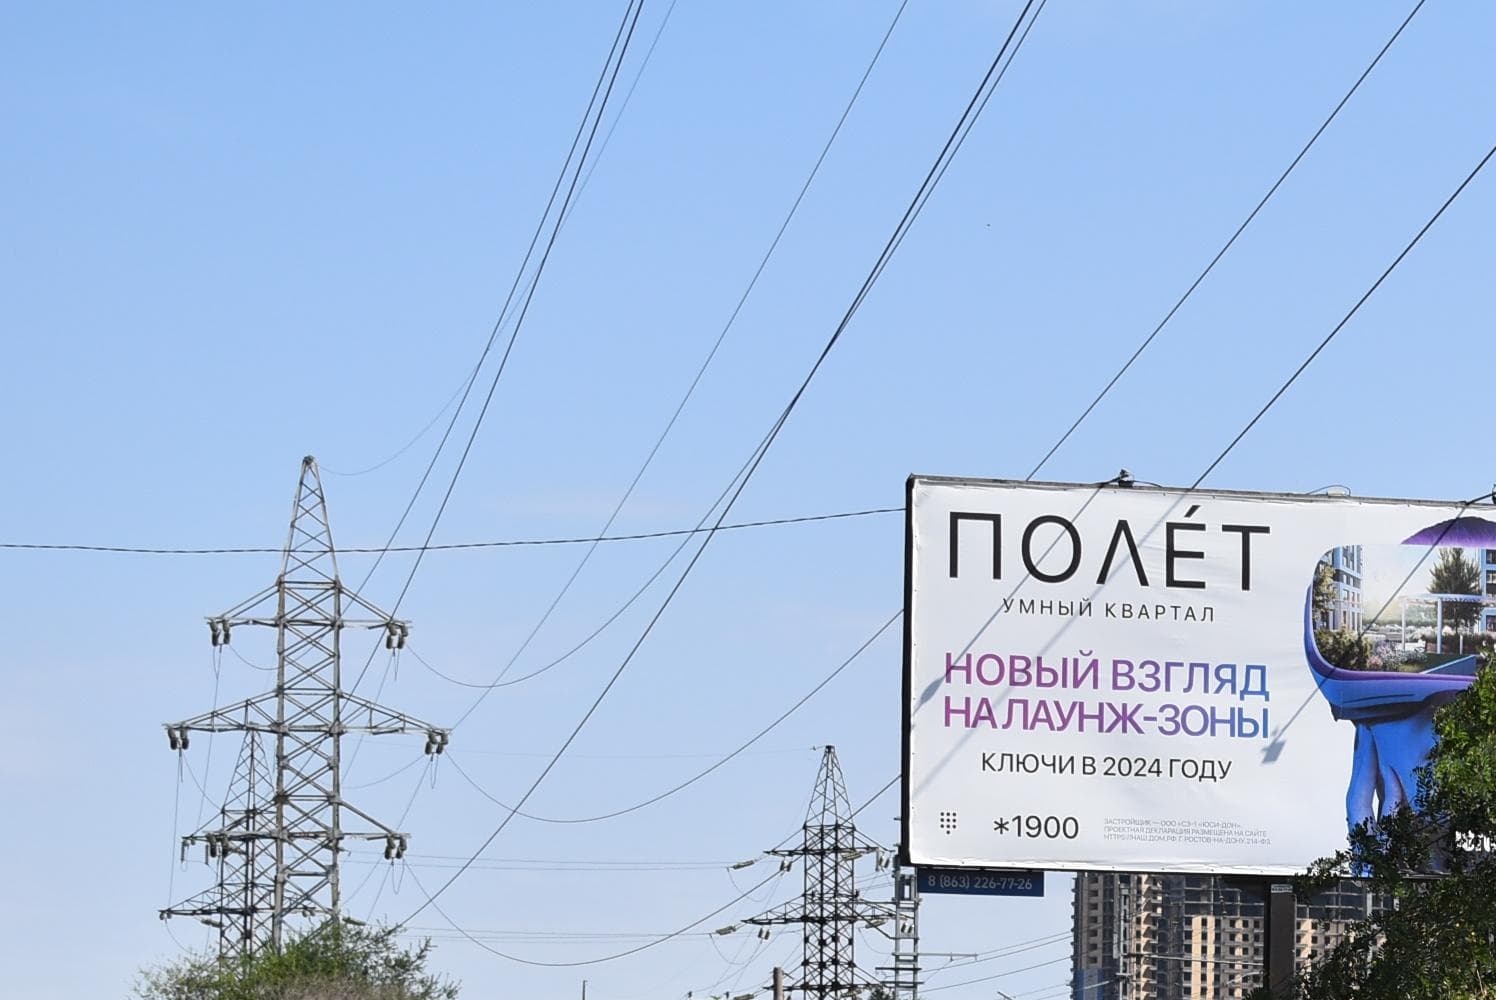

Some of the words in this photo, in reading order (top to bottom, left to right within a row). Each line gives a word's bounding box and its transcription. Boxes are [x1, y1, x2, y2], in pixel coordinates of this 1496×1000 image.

[1002, 598, 1093, 617] УМНЫЙ
[1105, 603, 1215, 622] КВАРТАЛ
[945, 650, 1099, 690] НОВЫЙ
[1112, 659, 1270, 702] ВЗГЛЯД
[944, 695, 998, 729] НА
[1002, 699, 1269, 738] ЛАУНЖ-ЗОНЫ
[981, 752, 1075, 775] КЛЮЧИ
[1083, 756, 1096, 775] В
[1103, 757, 1162, 778] 2024
[1168, 759, 1233, 782] ГОДУ
[928, 875, 936, 887] 8
[940, 875, 970, 889] (863)
[974, 877, 1033, 890] 226-77-26
